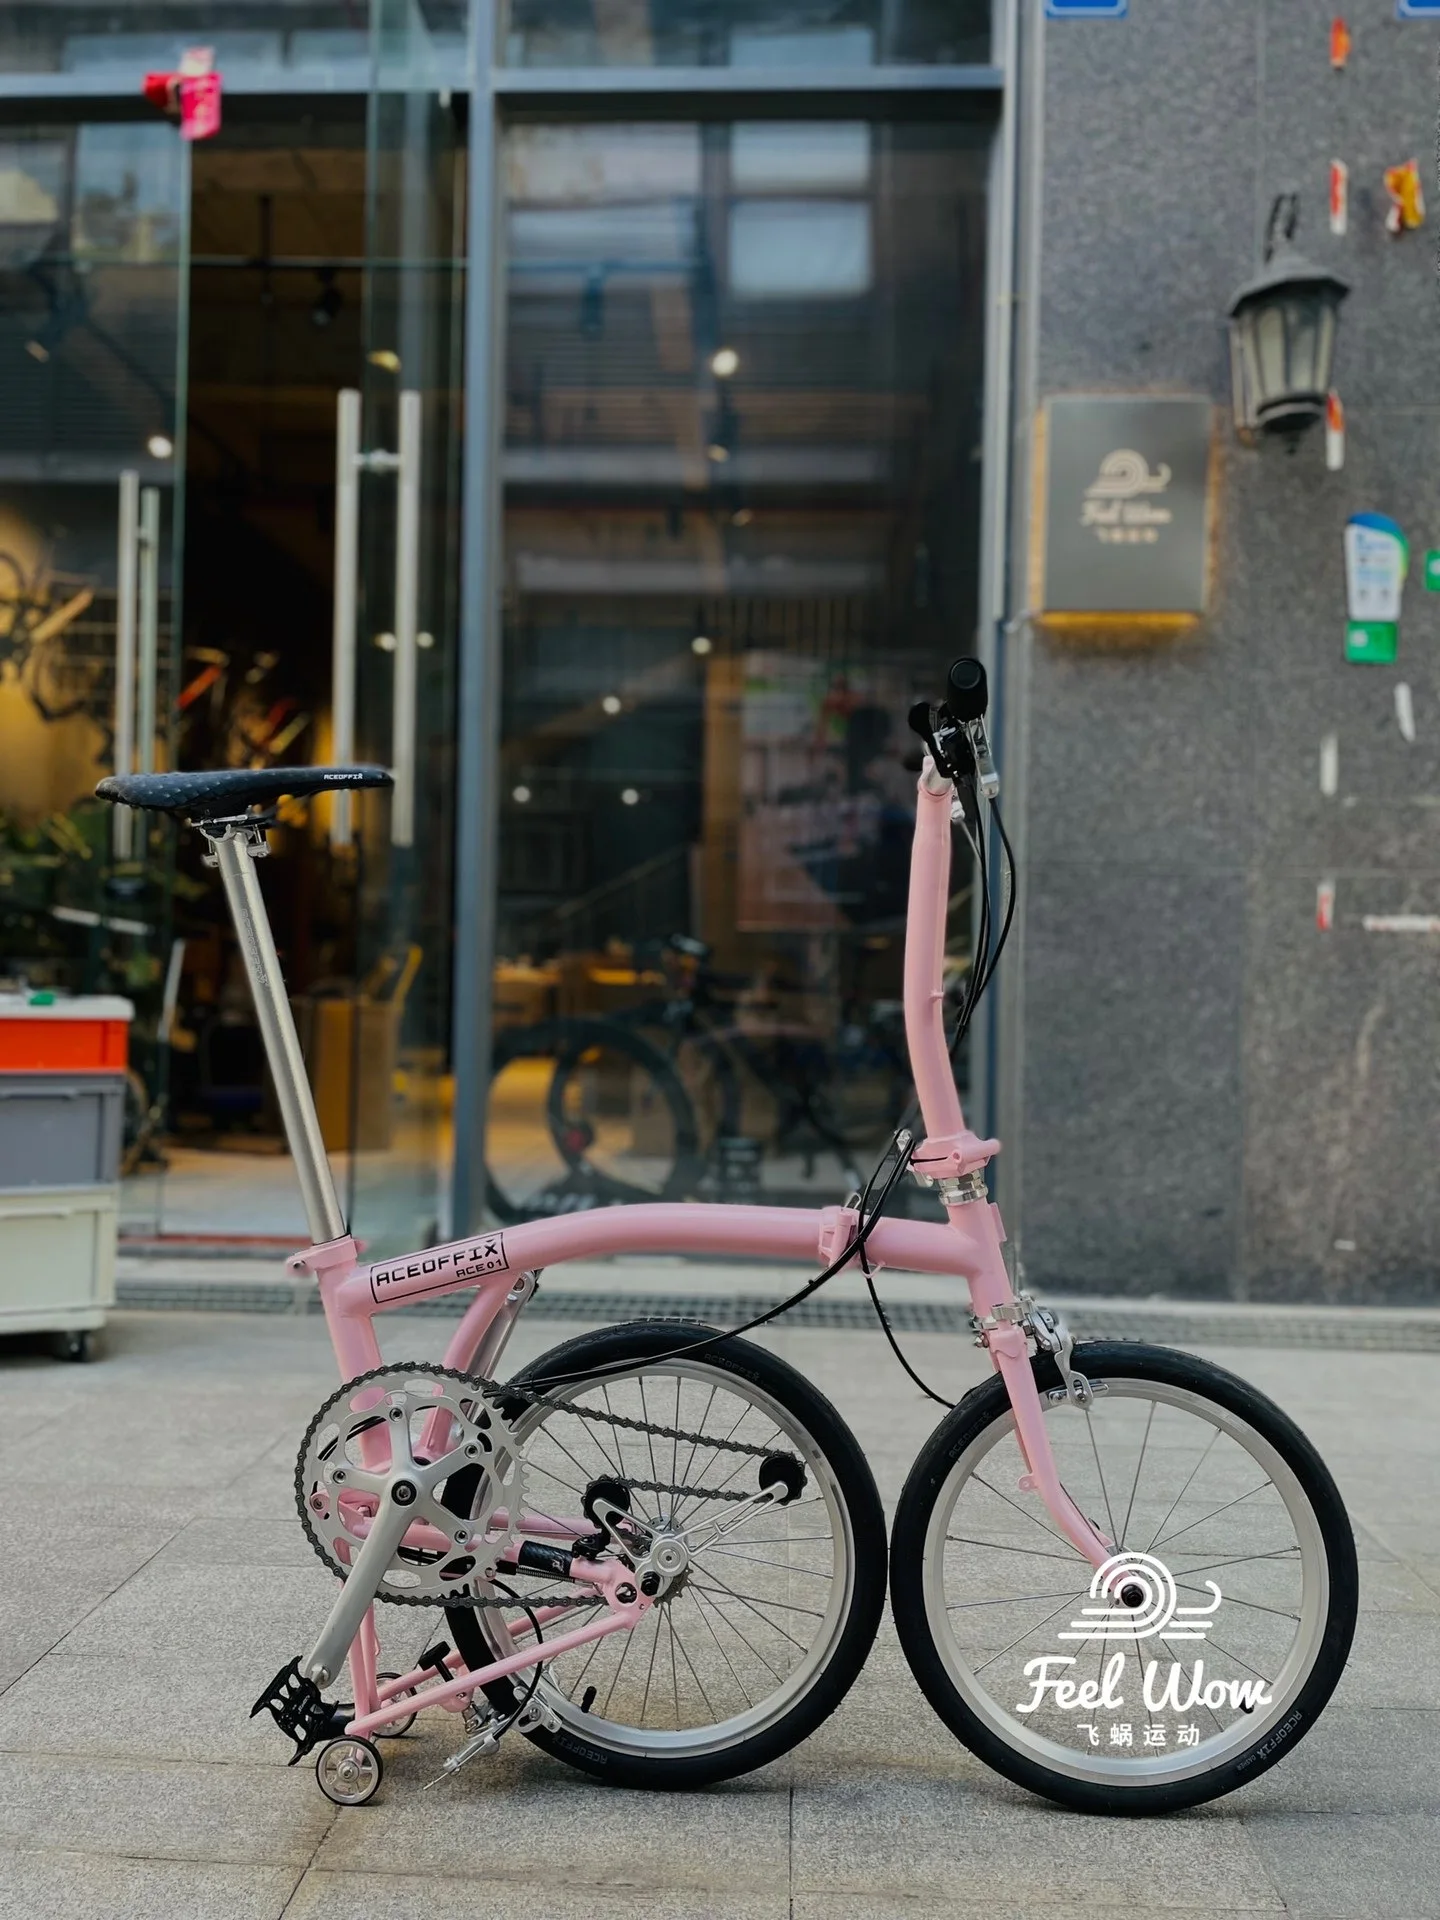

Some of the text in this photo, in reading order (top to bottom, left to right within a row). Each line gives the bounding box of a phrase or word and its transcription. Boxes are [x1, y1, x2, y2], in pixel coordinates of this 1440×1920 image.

[323, 772, 364, 780] ACEOFFIX
[376, 1239, 499, 1286] ACEOFFIX
[1256, 1710, 1303, 1761] ACEOFFIX
